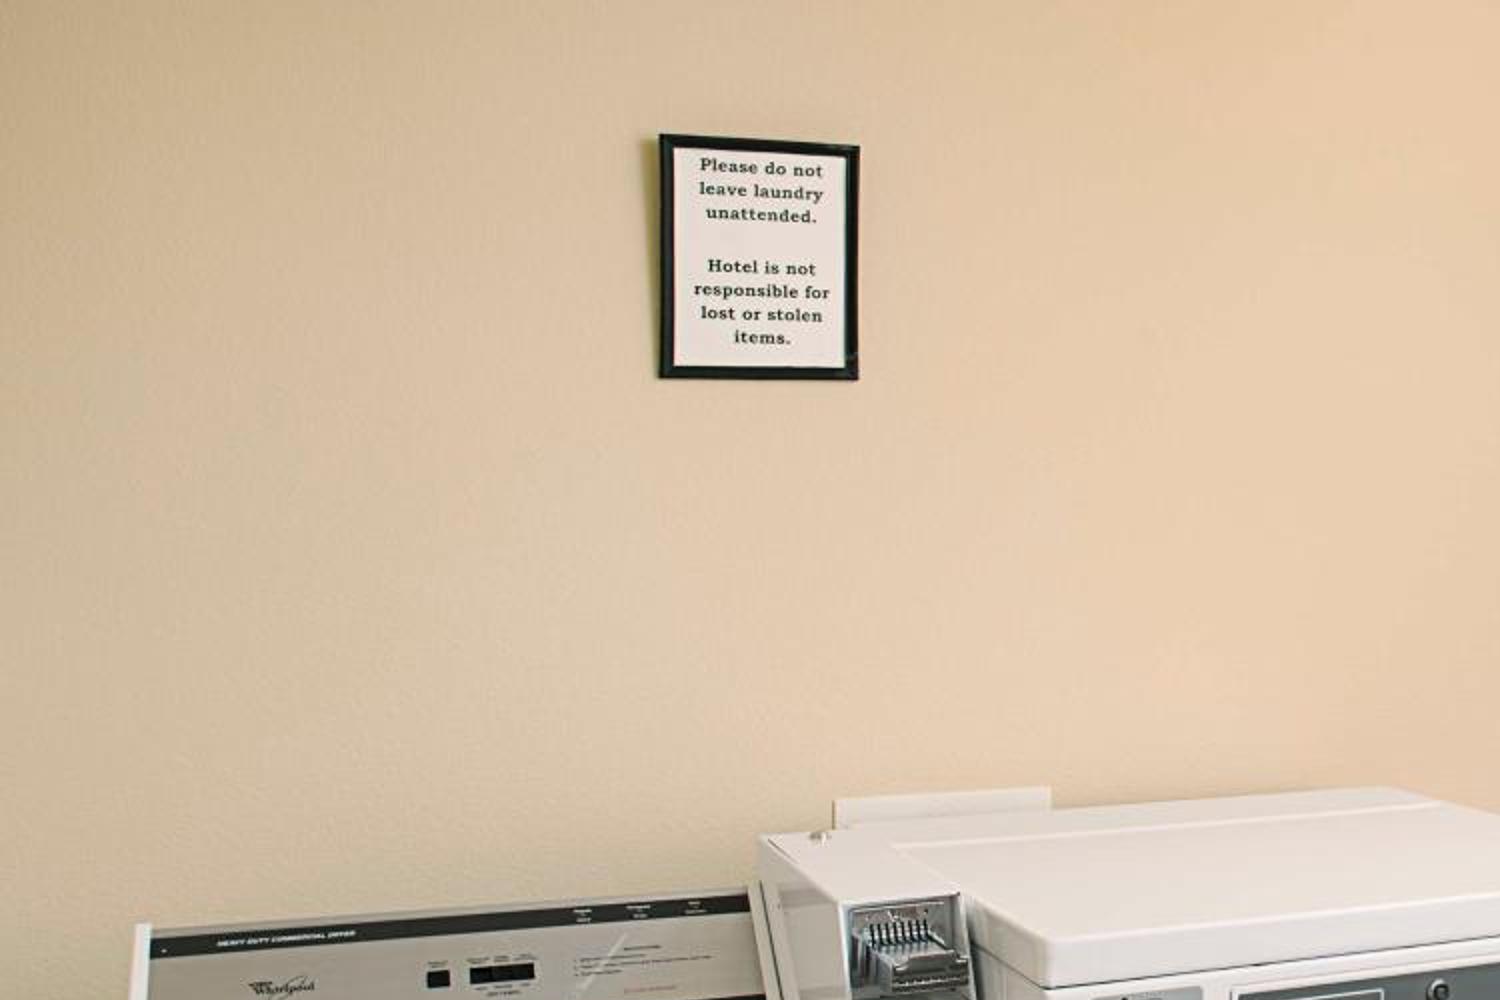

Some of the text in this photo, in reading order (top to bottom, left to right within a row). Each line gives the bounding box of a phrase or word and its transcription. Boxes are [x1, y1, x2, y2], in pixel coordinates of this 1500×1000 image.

[700, 157, 824, 178] Please do not
[699, 181, 824, 204] leave laundry
[705, 207, 817, 224] unattended.
[707, 259, 816, 277] Hotel is not
[693, 284, 831, 300] responsible for
[700, 306, 823, 323] lost or stolen
[734, 330, 792, 345] items.
[248, 978, 315, 999] Whirlpool
